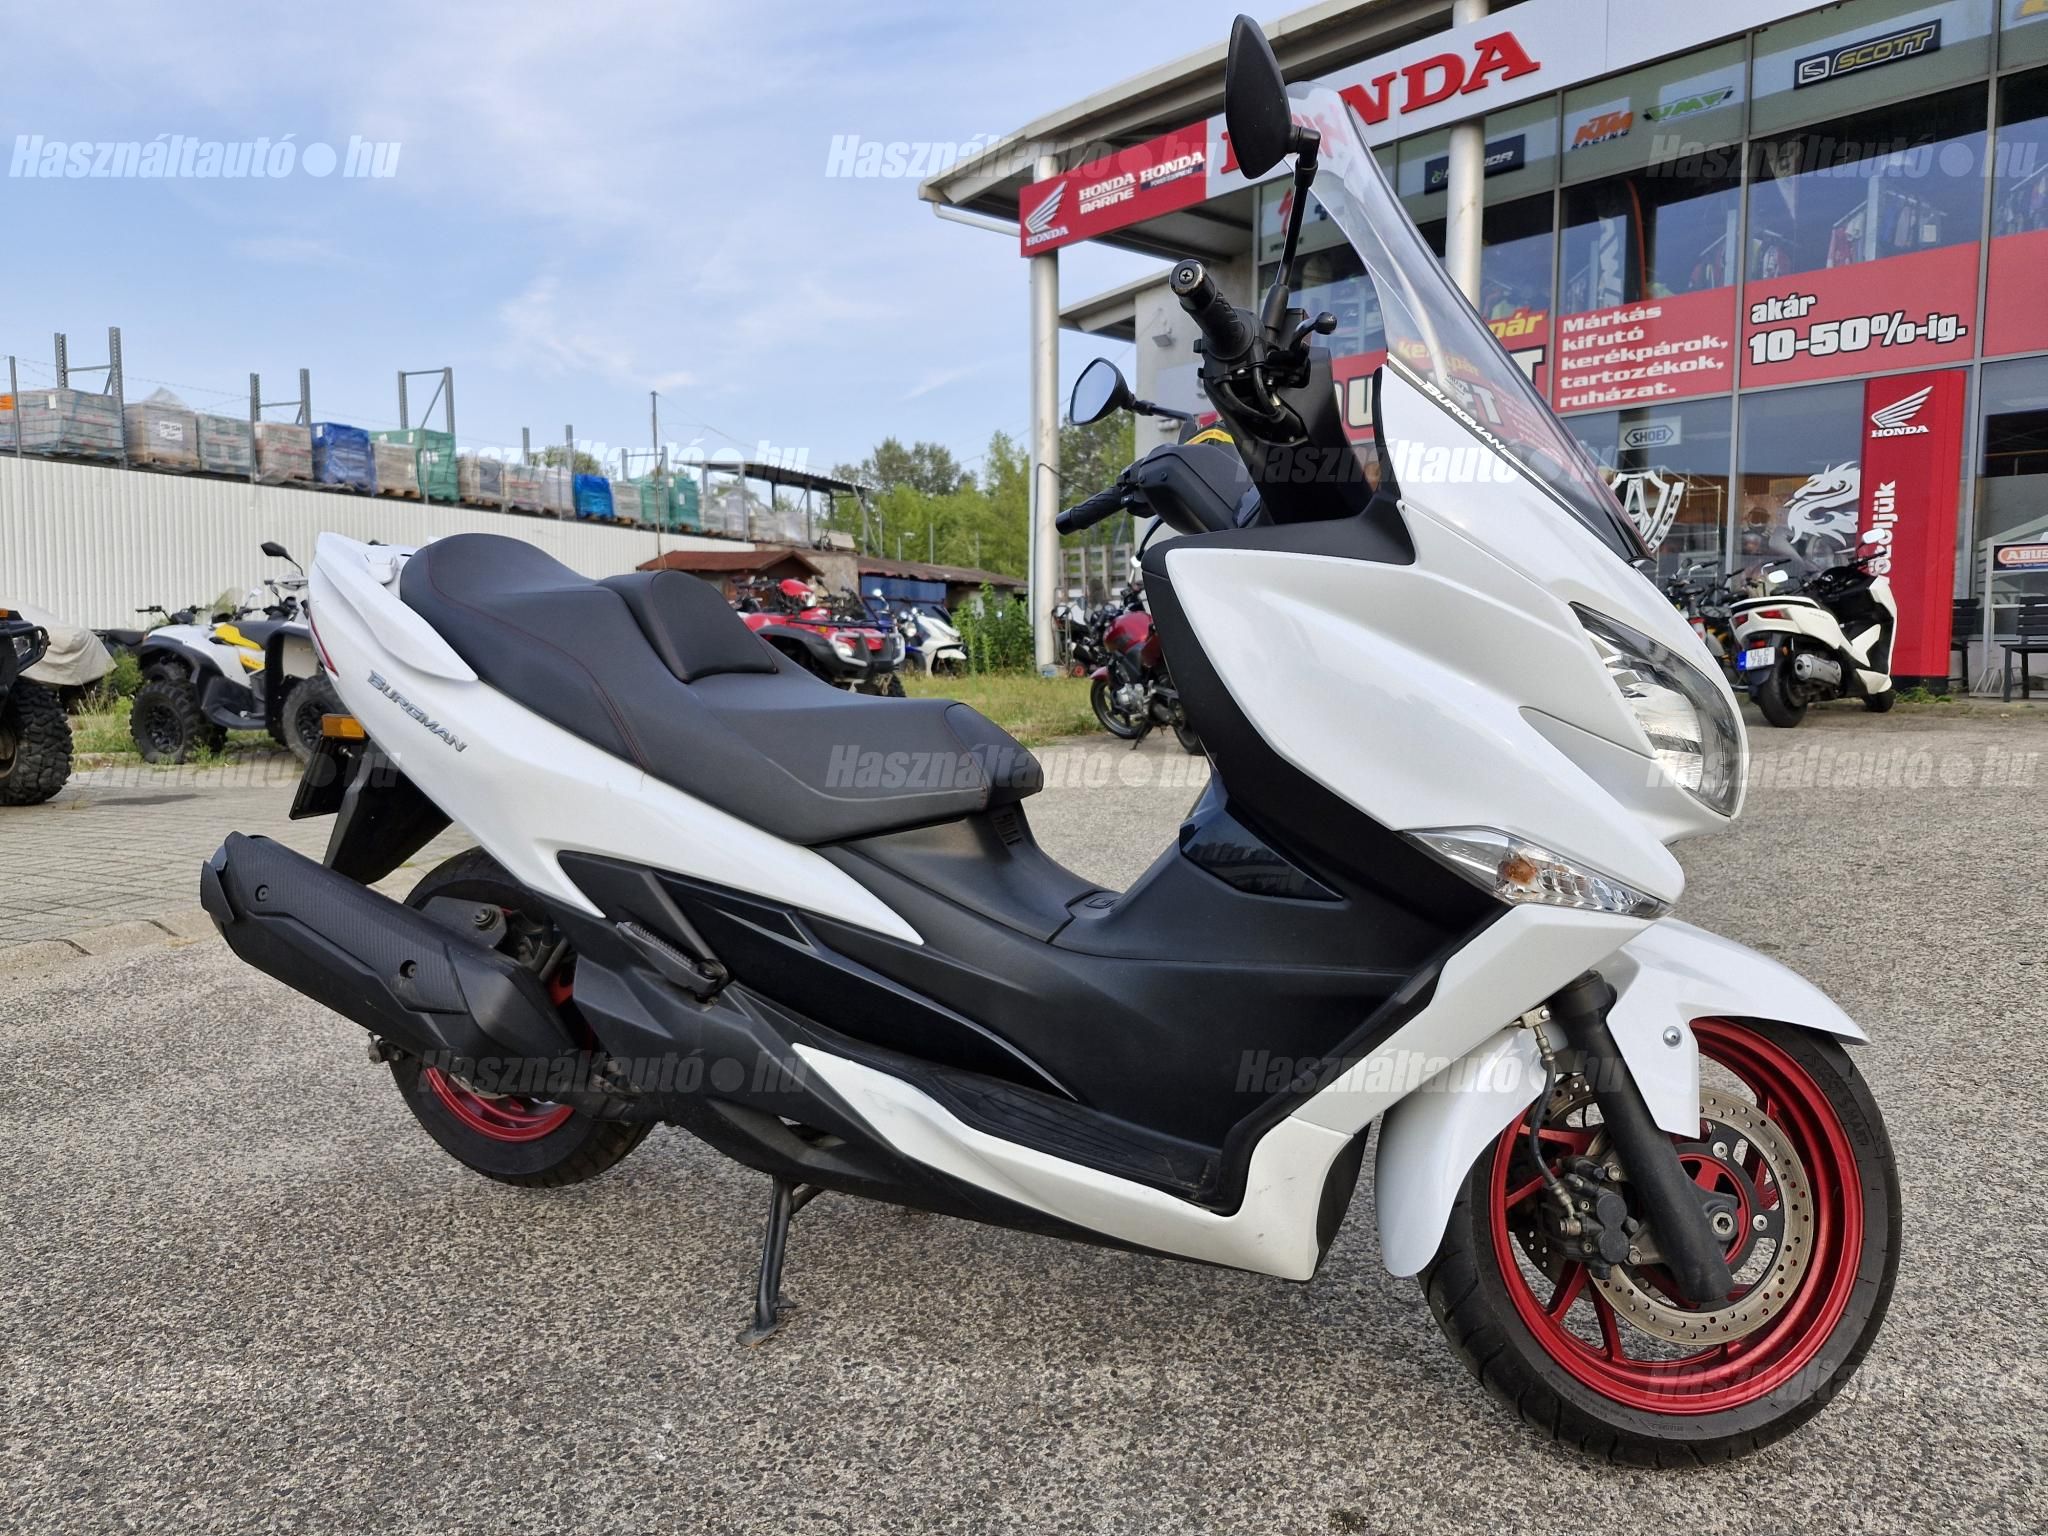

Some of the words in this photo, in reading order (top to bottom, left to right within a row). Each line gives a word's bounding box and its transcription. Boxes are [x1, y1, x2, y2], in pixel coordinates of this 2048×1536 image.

[1837, 31, 1931, 69] SCOTT
[1570, 129, 1629, 151] RACING
[1574, 111, 1634, 145] KTM
[1140, 151, 1206, 183] HONDA
[1078, 172, 1137, 200] HONDA
[1079, 187, 1135, 214] MARINE
[1026, 226, 1069, 246] HONDA
[1562, 306, 1662, 333] Márkás
[1750, 293, 1817, 324] akár
[1561, 326, 1645, 352] kifutó
[1748, 310, 1969, 364] 10-50%-ig.
[1560, 335, 1729, 371] kerékpárok,
[1560, 355, 1725, 389] tartozékok,
[1560, 382, 1677, 408] ruházat.
[1421, 381, 1506, 450] BURGMAN
[1632, 430, 1666, 444] SHOEI
[1871, 425, 1930, 438] HONDA
[367, 670, 468, 752] BURGMAN
